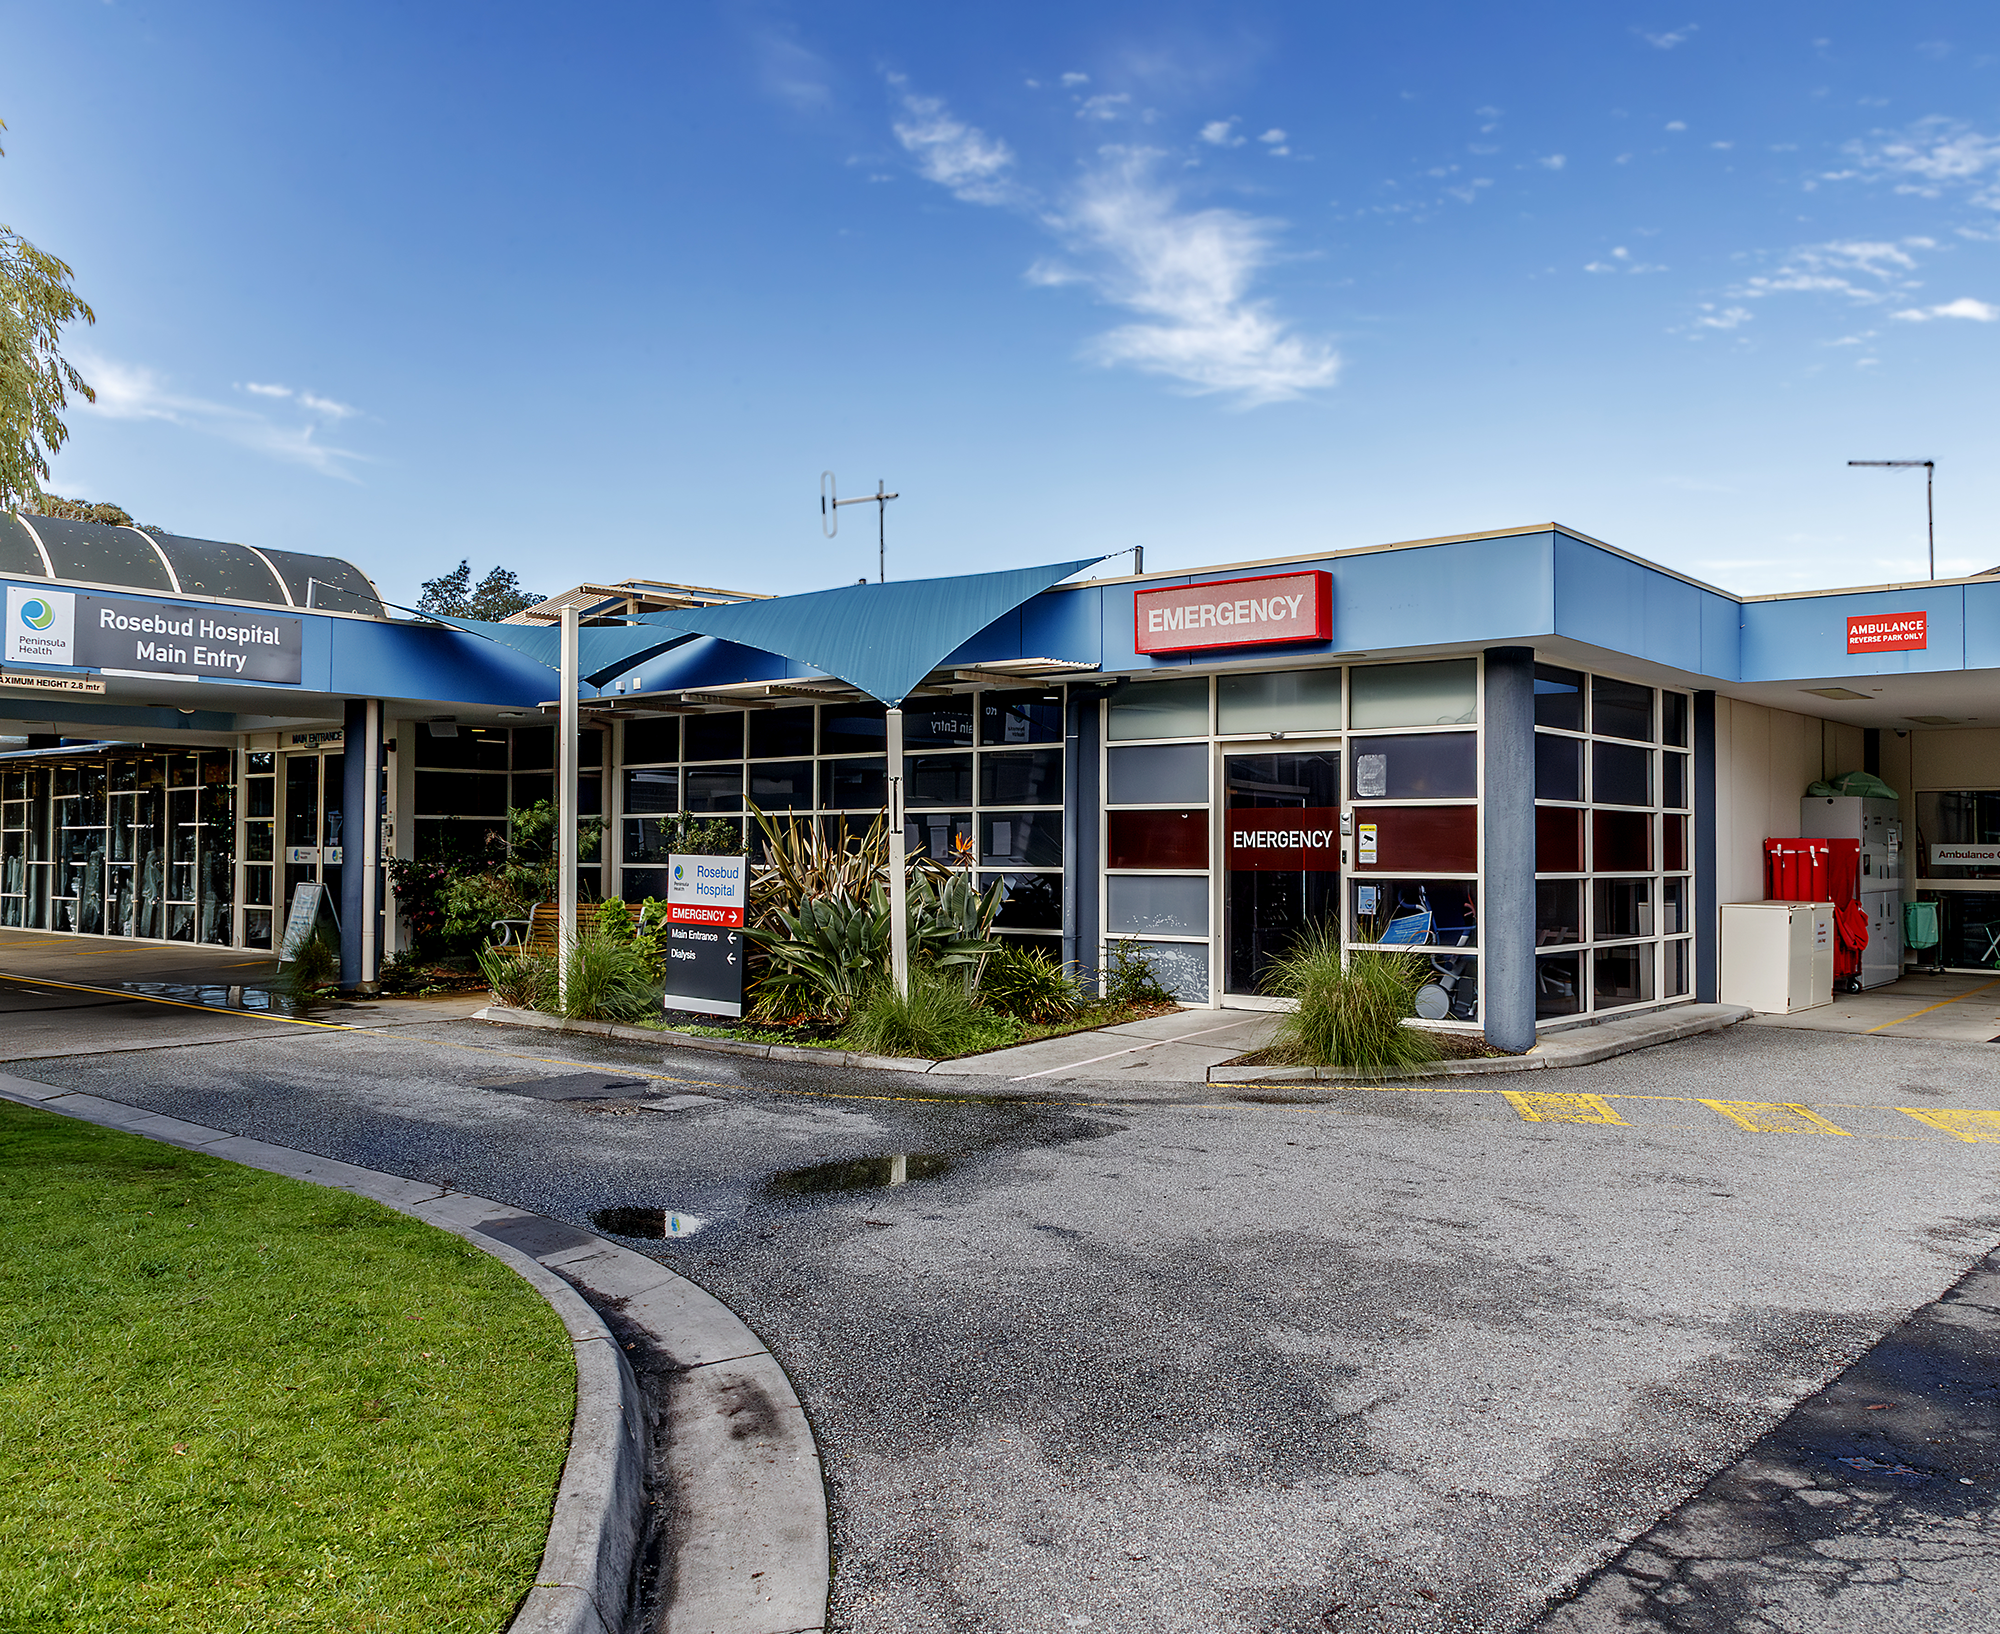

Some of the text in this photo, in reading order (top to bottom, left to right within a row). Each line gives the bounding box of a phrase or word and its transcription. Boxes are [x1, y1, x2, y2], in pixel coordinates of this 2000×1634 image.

[1149, 594, 1304, 633] EMERGENCY
[100, 608, 280, 646] Rosebud Hospital
[1850, 620, 1924, 635] AMBULANCE
[19, 636, 66, 648] Peninsula
[1849, 632, 1924, 644] REVERSE PARK ONLY
[19, 645, 53, 655] Health
[136, 641, 248, 673] Main Entry
[0, 676, 34, 686] AXIMUM
[36, 679, 68, 688] HEIGHT
[71, 681, 84, 690] 2.8
[308, 731, 343, 743] ENTRANCE
[1233, 830, 1334, 848] EMERGENCY
[1938, 850, 1995, 859] Ambulance
[697, 865, 739, 879] Rosebud
[696, 882, 735, 898] Hospital
[672, 907, 725, 922] EMERGENCY
[671, 928, 718, 942] Main Entrance
[670, 948, 696, 961] Dialysis
